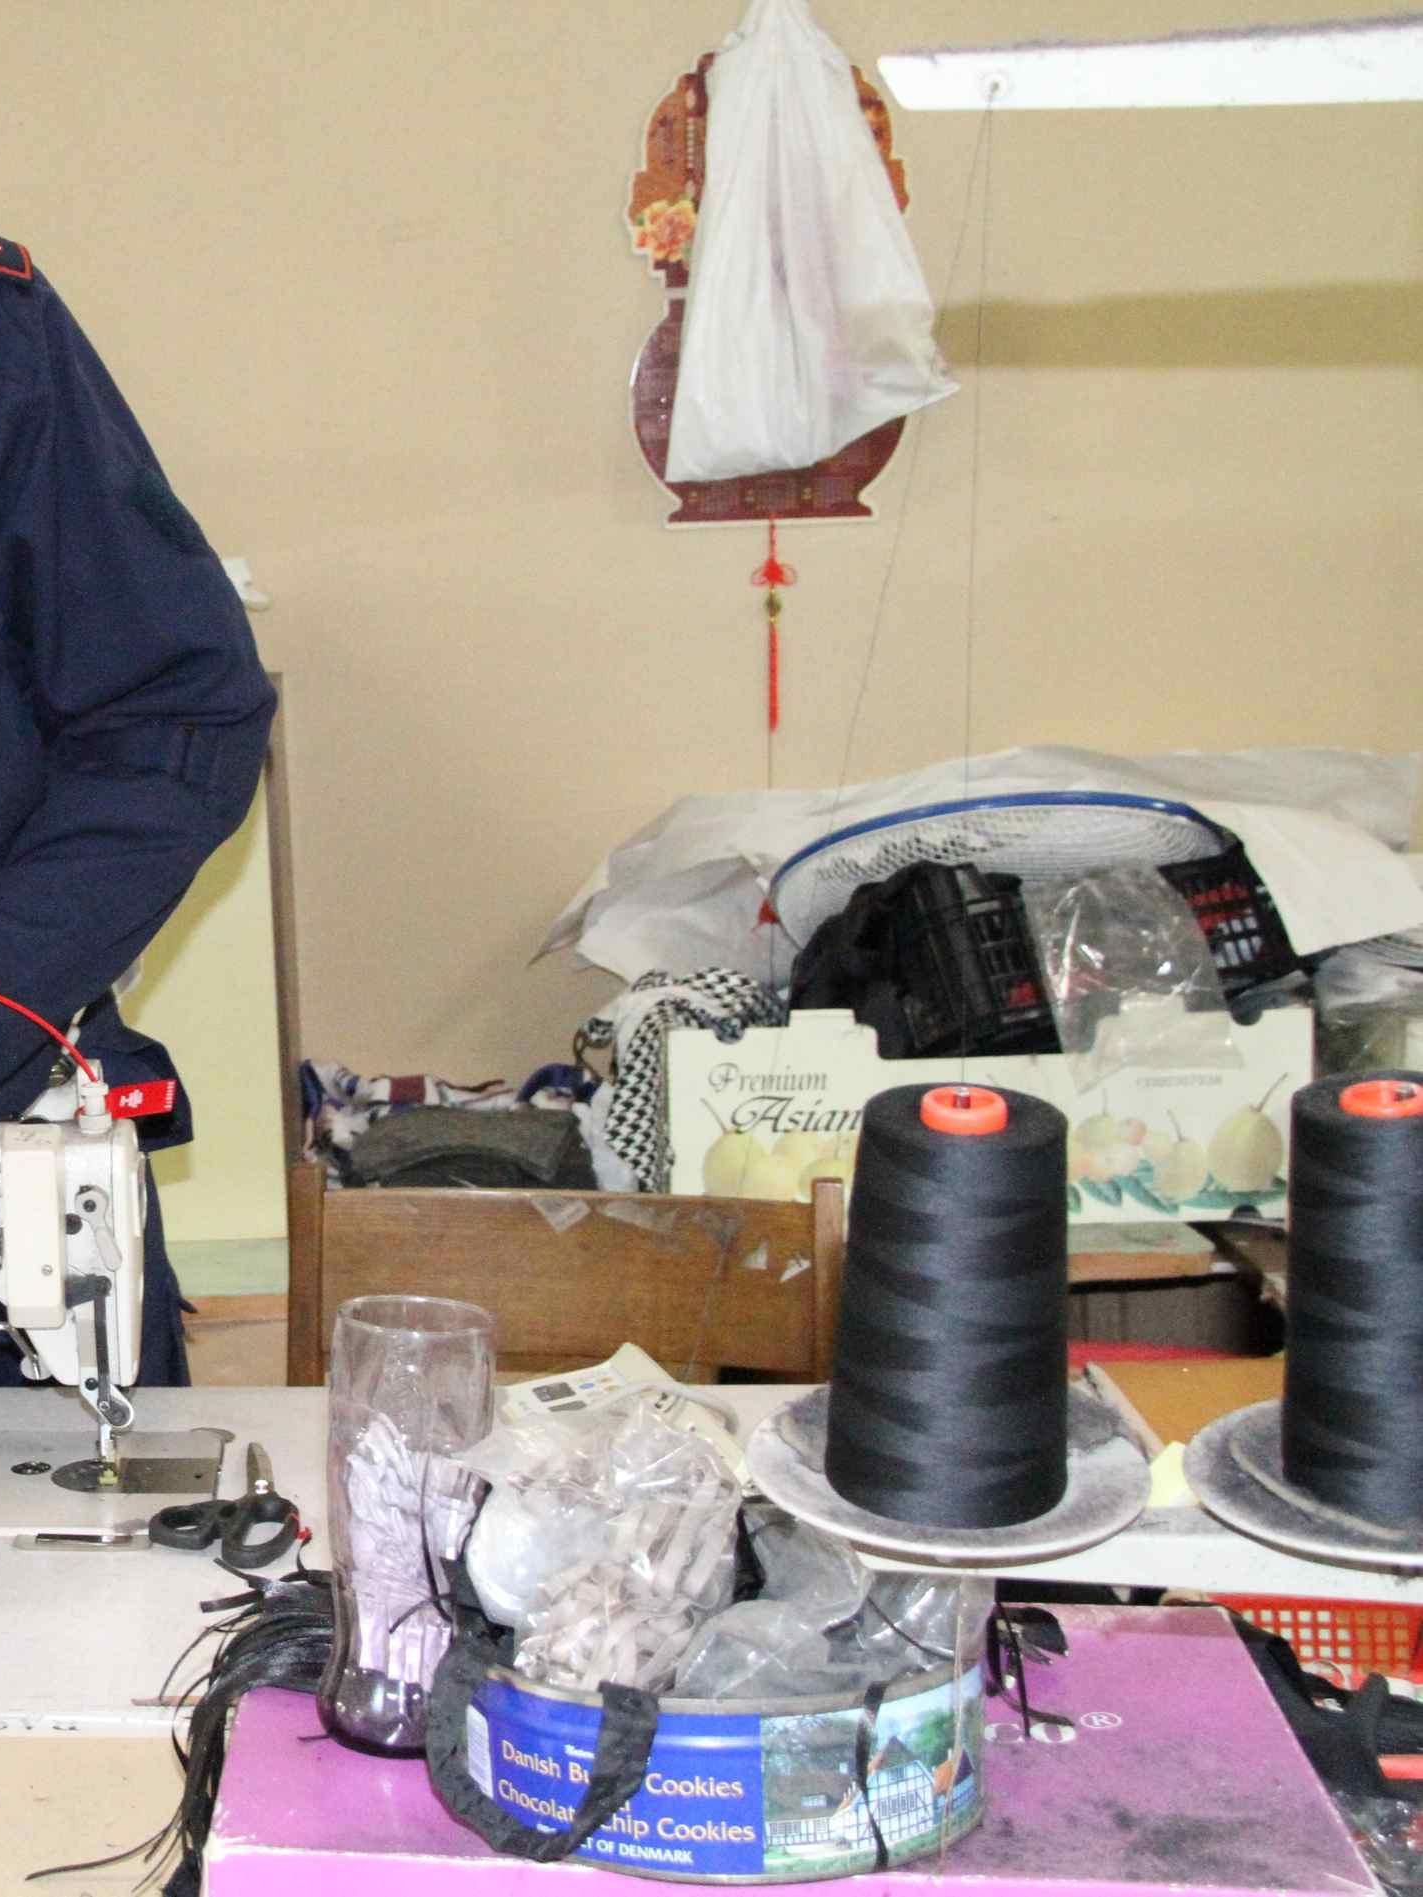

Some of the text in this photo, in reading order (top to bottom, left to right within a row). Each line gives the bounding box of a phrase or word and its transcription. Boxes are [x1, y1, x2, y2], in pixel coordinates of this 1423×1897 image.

[707, 1061, 827, 1093] Premium
[730, 1095, 865, 1135] Asian
[501, 1739, 562, 1779] Danish
[644, 1772, 745, 1799] Cookies
[497, 1778, 576, 1825] Chocolat
[656, 1816, 758, 1843] Cookies
[597, 1838, 615, 1855] OF
[618, 1842, 695, 1865] DENMARK
